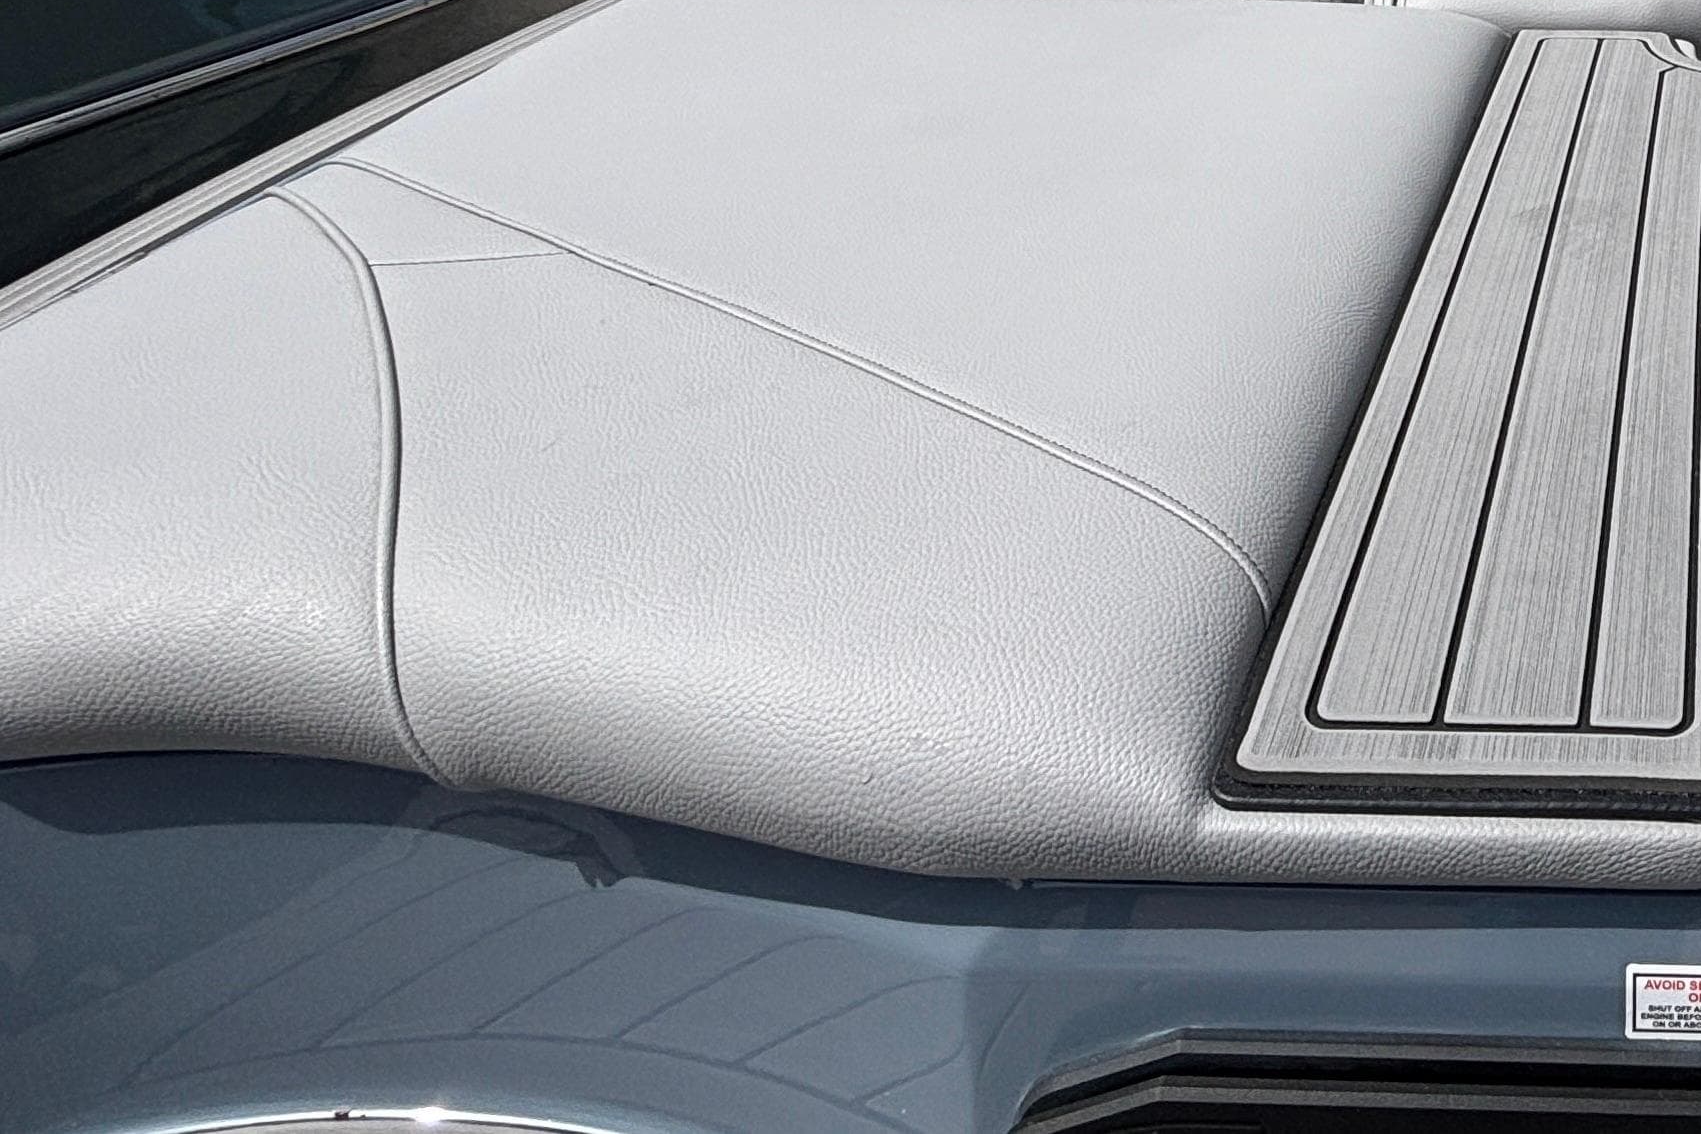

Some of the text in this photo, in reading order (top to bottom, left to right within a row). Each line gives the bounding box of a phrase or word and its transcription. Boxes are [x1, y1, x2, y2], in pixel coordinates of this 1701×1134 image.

[1644, 979, 1686, 991] AVOID
[1648, 1004, 1672, 1012] SHUT
[1674, 1005, 1692, 1013] OFF
[1640, 1012, 1675, 1020] ENGINE
[1652, 1020, 1666, 1028] ON
